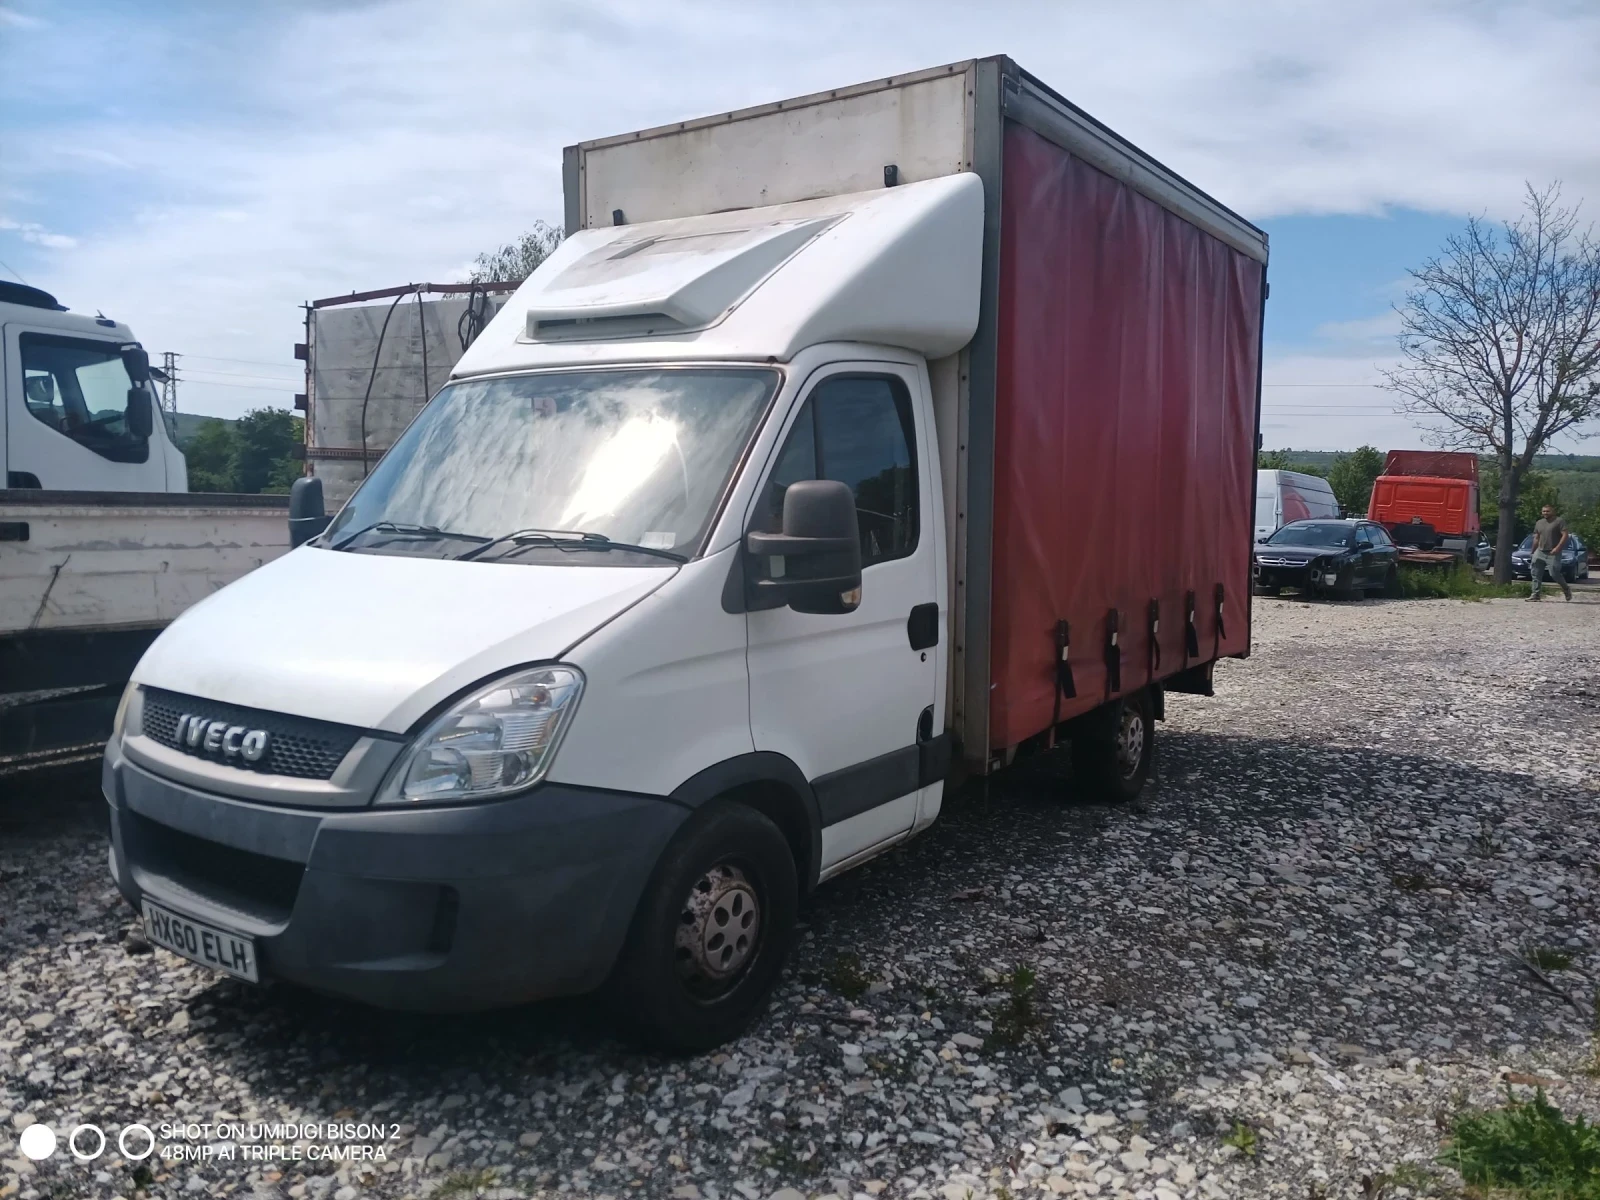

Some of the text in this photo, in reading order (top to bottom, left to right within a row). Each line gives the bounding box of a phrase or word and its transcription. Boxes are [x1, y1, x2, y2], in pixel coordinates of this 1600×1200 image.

[175, 714, 269, 762] IVECO
[148, 907, 248, 973] HX60 ELH
